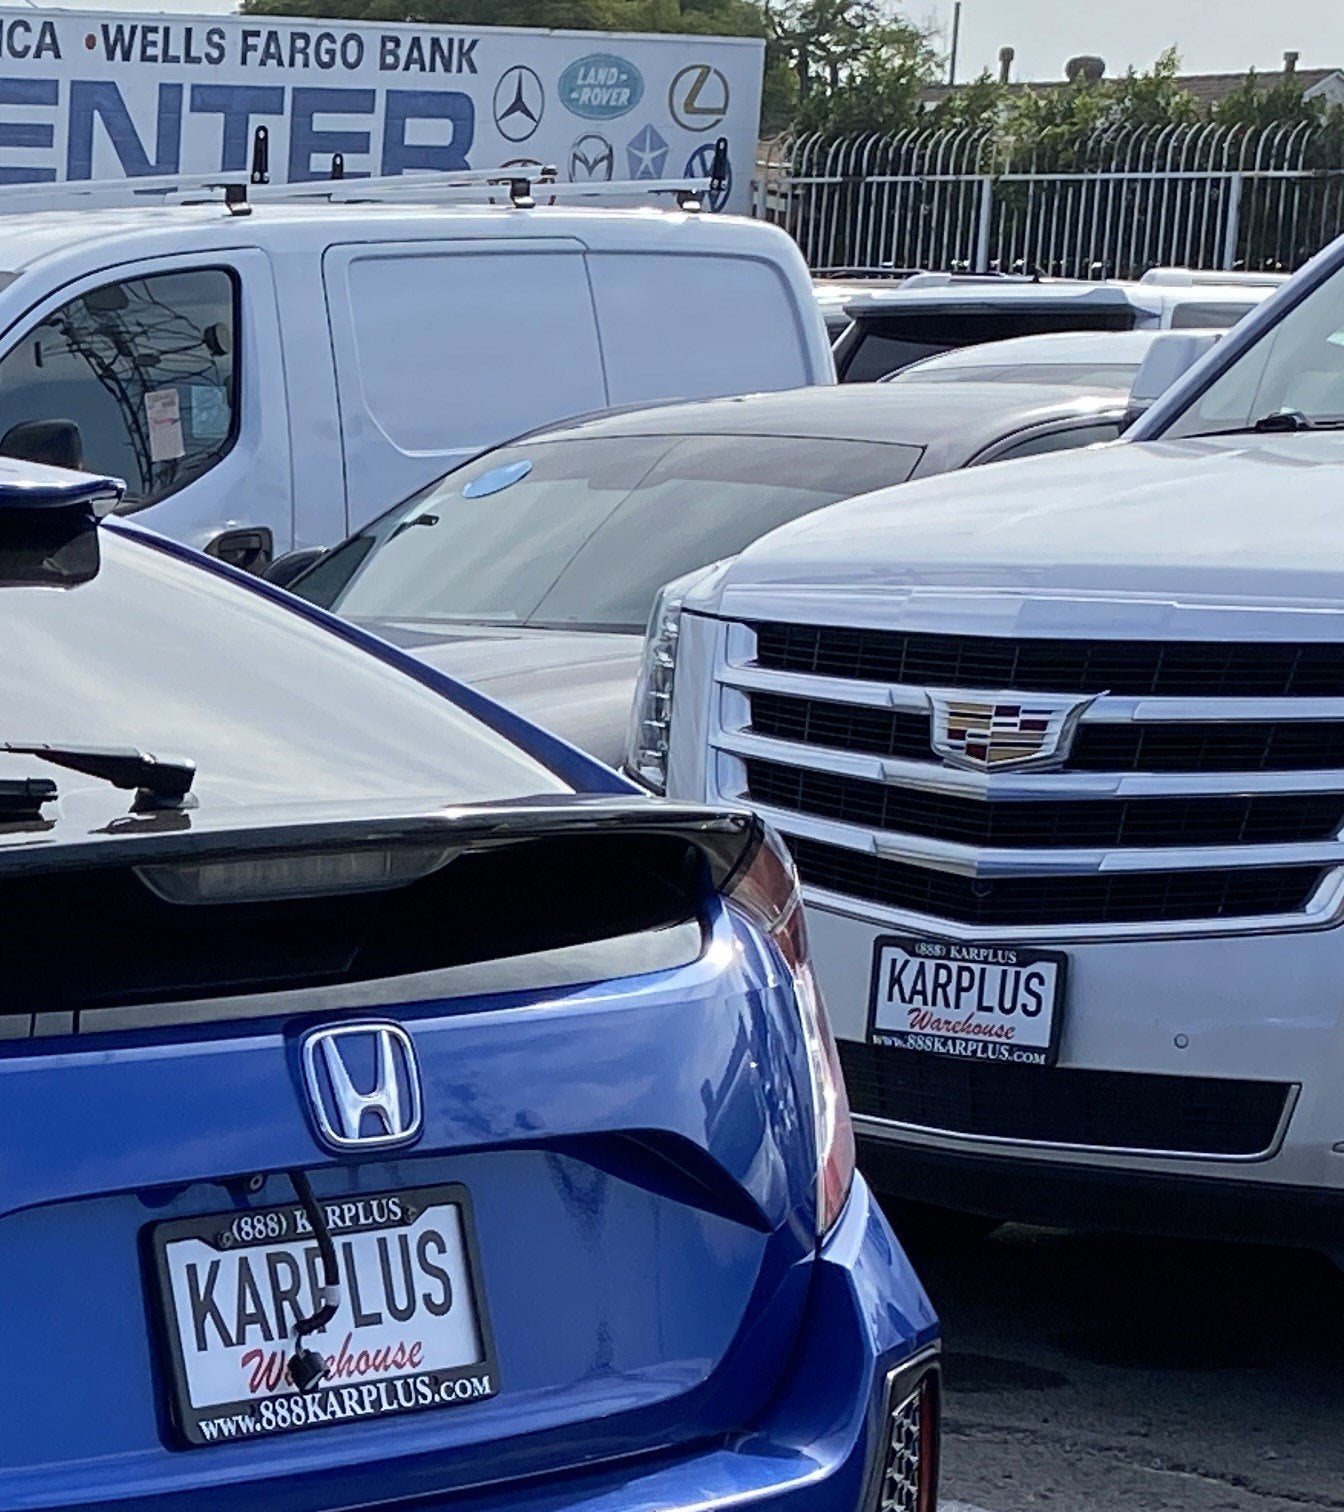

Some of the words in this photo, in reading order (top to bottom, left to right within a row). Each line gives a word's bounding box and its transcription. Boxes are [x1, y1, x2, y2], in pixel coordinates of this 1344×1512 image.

[101, 23, 226, 66] WELLS
[240, 29, 364, 71] FARGO
[378, 35, 480, 75] BANK
[949, 944, 1017, 965] KARPLUS
[886, 957, 1046, 1018] KARPLUS
[907, 1007, 1016, 1041] Warehouse
[231, 1211, 288, 1242] (888)
[296, 1197, 403, 1235] KRPLUS
